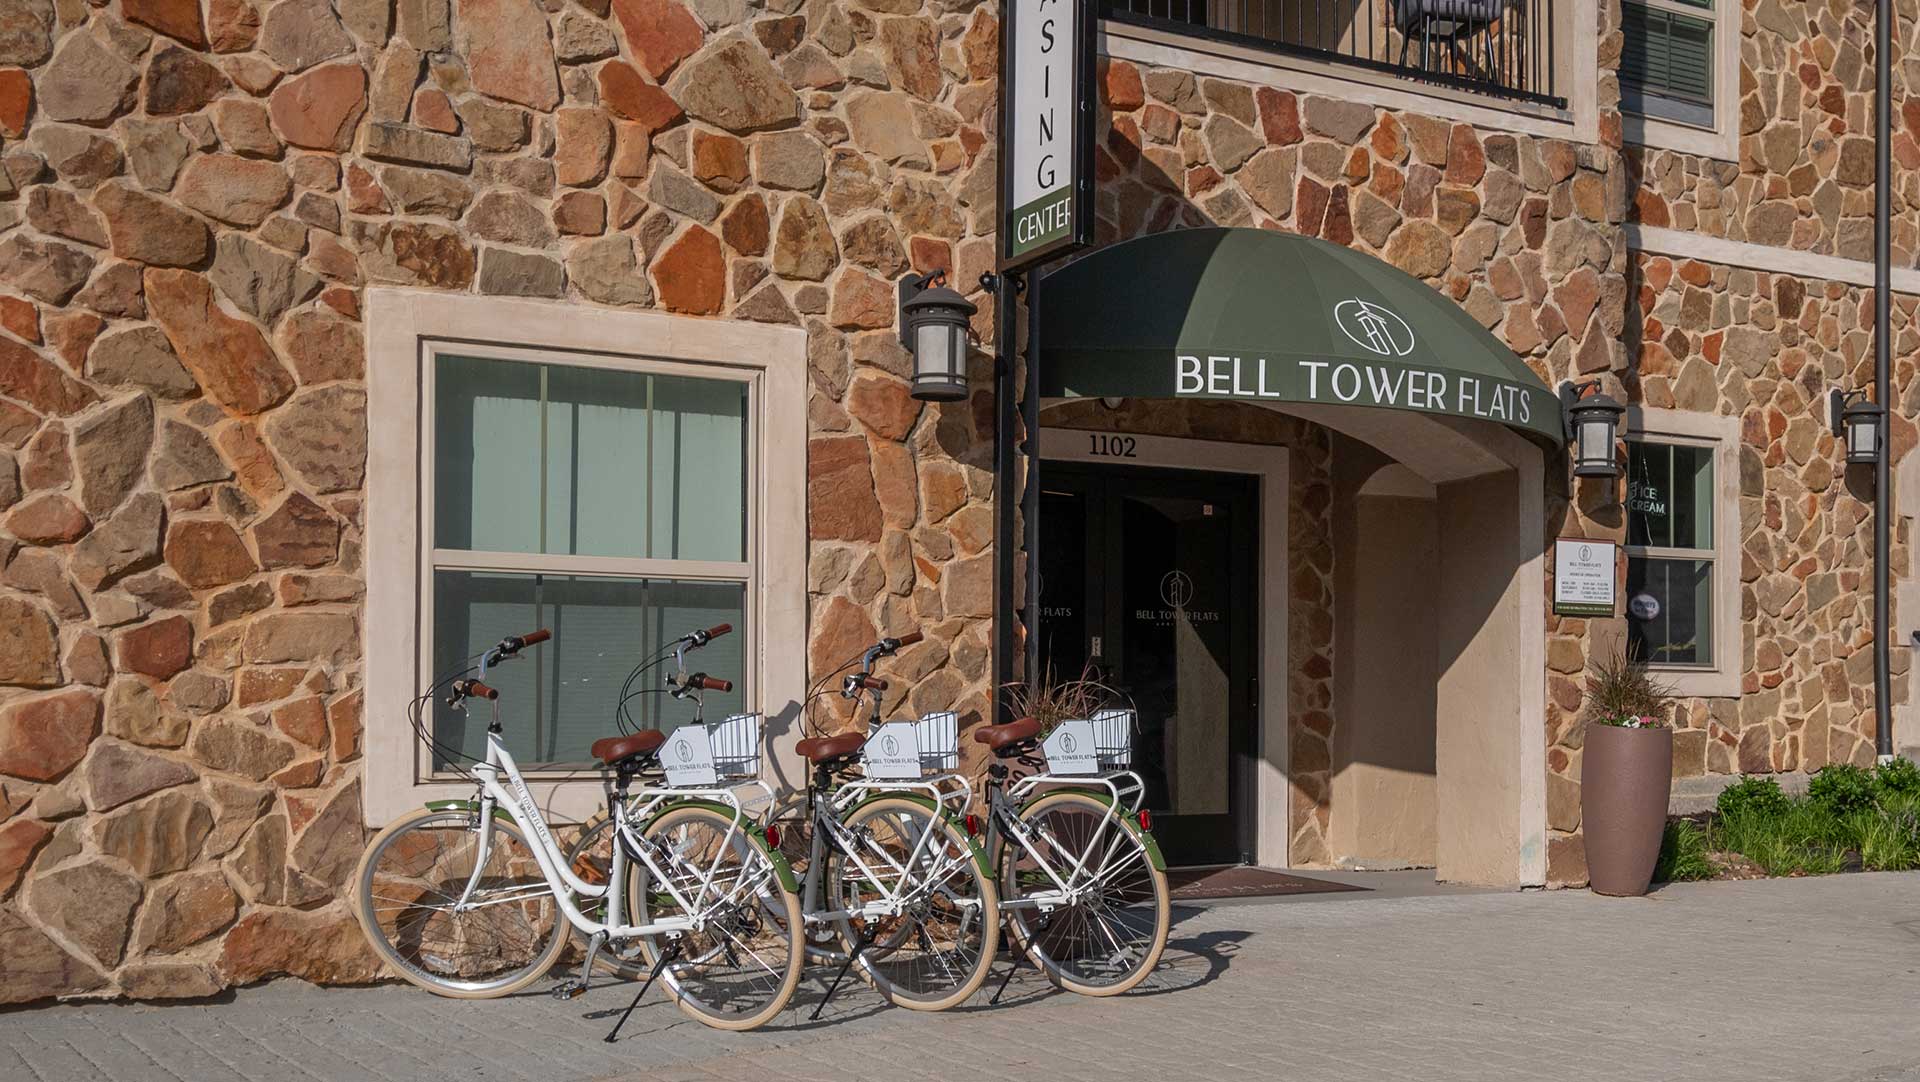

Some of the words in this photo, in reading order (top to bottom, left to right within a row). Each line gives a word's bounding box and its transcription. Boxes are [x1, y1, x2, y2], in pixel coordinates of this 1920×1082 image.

[1176, 355, 1281, 397] BELL
[1298, 360, 1447, 411] TOWER
[1458, 376, 1531, 424] FLATS
[1089, 434, 1137, 458] 1102
[1630, 499, 1665, 514] CREAM
[1044, 607, 1072, 617] FLATS
[1136, 610, 1156, 620] BELL
[1193, 611, 1219, 621] FLATS
